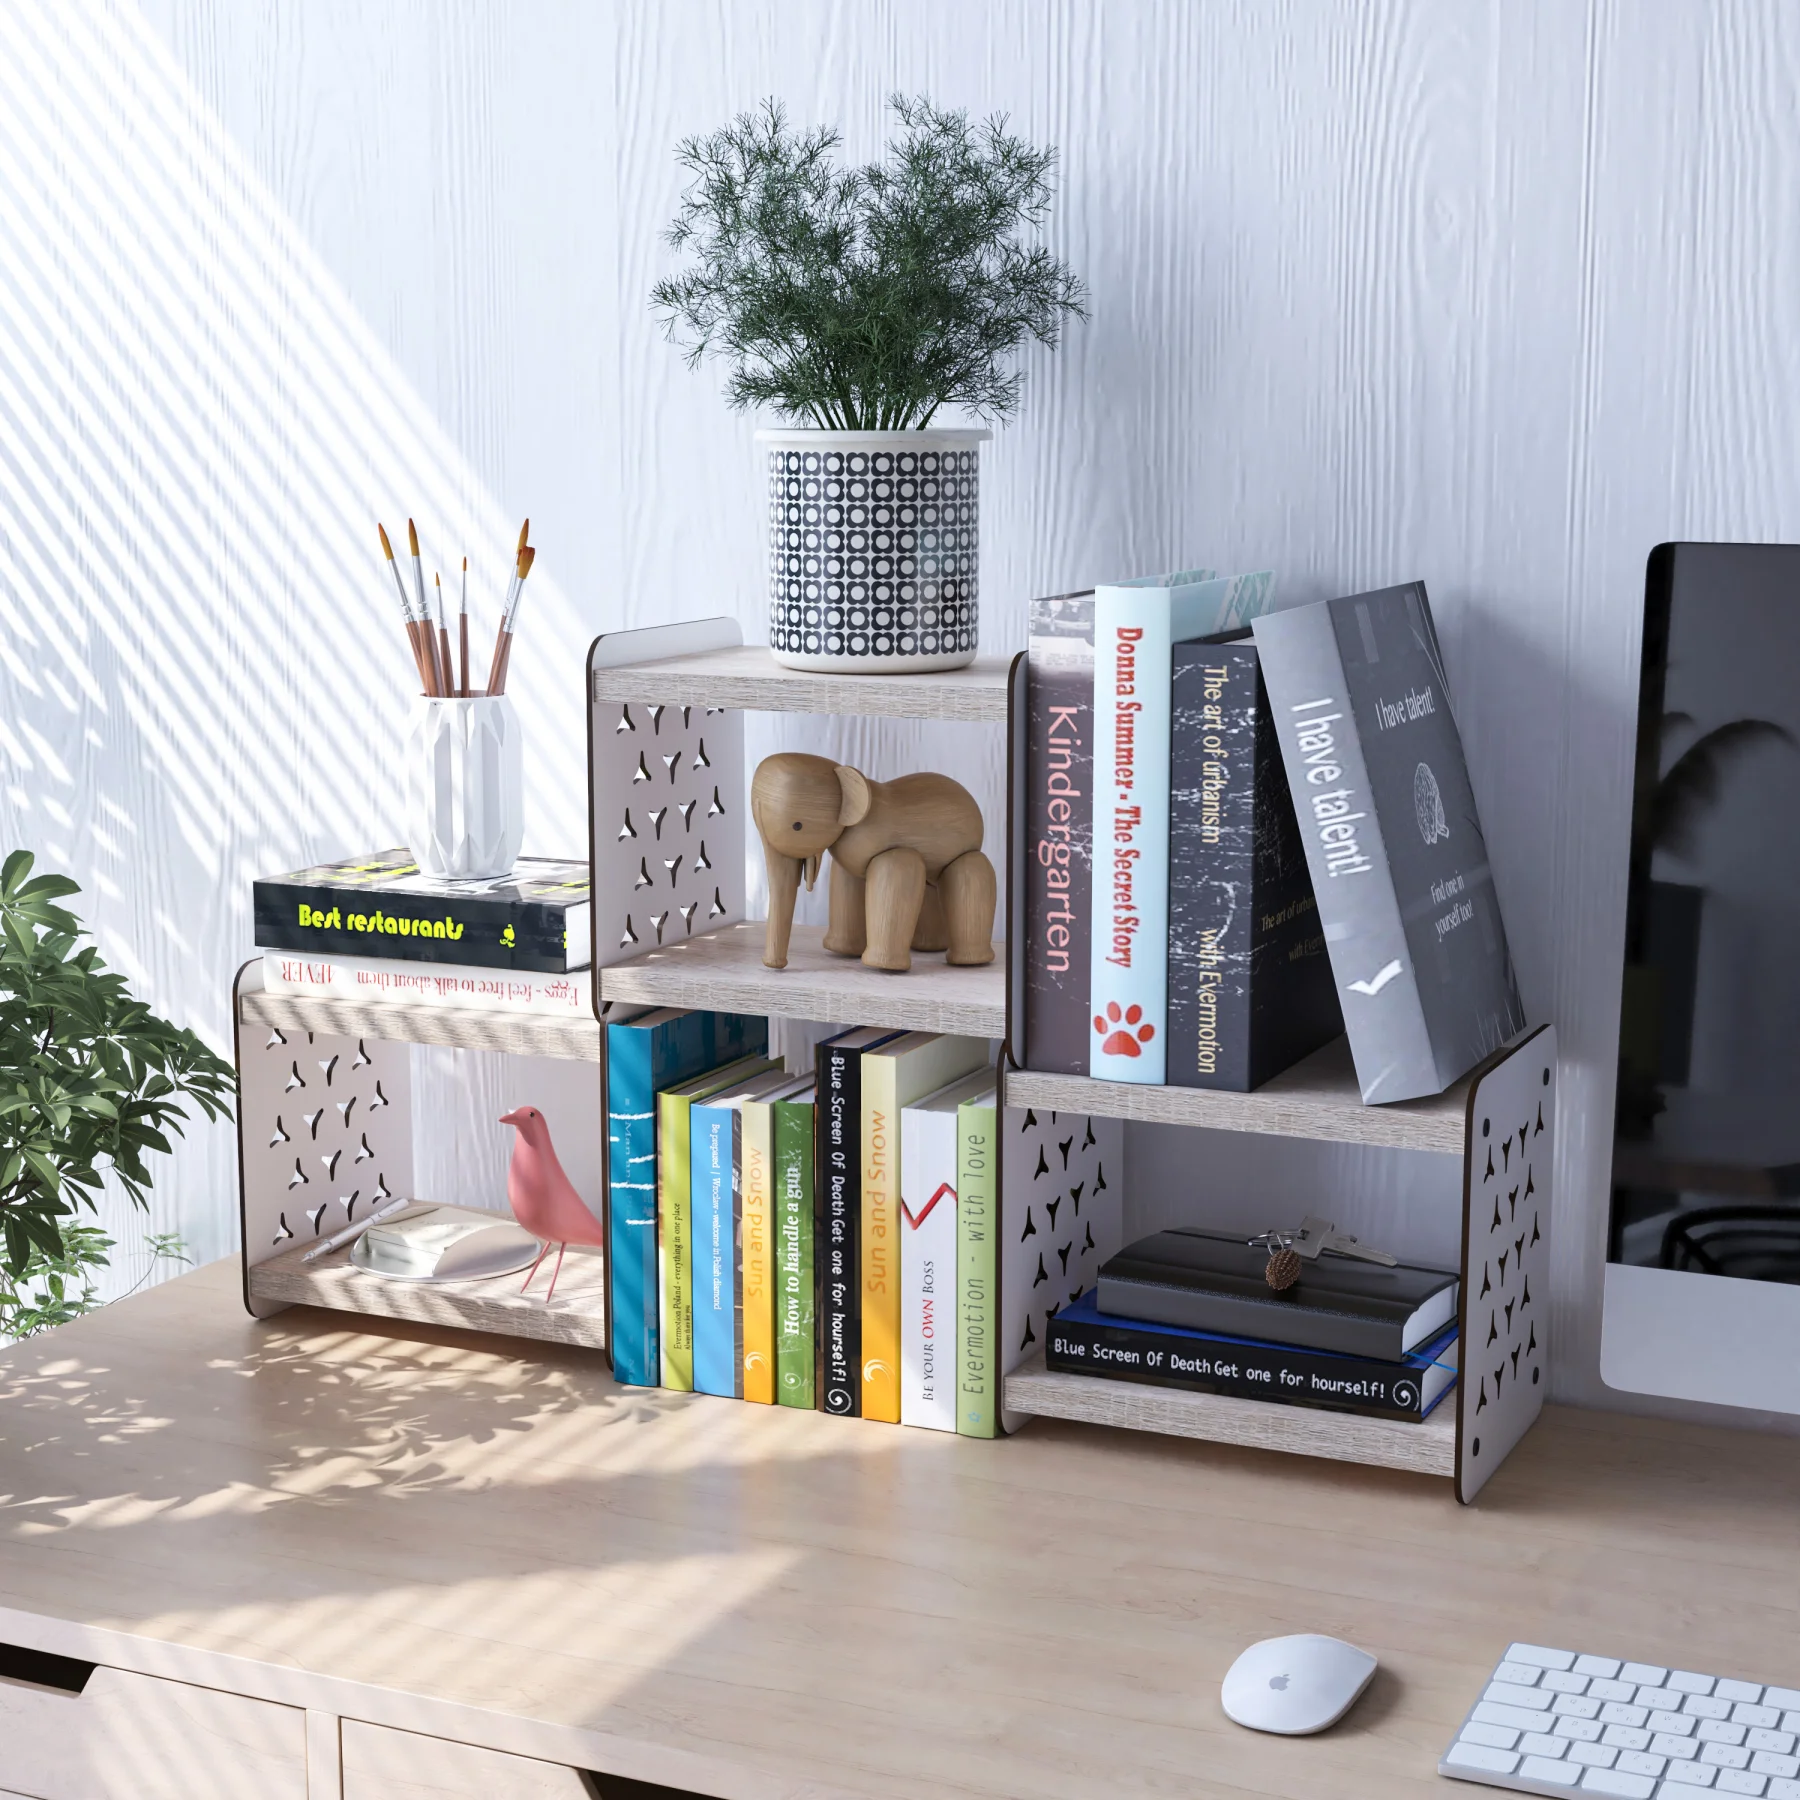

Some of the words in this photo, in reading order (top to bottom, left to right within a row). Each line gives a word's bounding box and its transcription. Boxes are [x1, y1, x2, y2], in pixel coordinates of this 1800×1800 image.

[1115, 627, 1143, 696] Donna
[1203, 665, 1230, 700] The
[1203, 705, 1227, 731] art
[1290, 697, 1335, 712] I
[1375, 703, 1383, 731] I
[1380, 697, 1407, 729] have
[1404, 685, 1436, 721] talent!
[1114, 701, 1143, 790] Summer
[1203, 735, 1229, 759] of
[1294, 713, 1343, 785] have
[1202, 761, 1229, 844] urbanism
[1037, 705, 1082, 973] Kindergarten
[1113, 805, 1142, 844] The
[1311, 789, 1374, 878] talent!
[1113, 848, 1141, 911] Secret
[1430, 879, 1446, 905] Find
[1445, 878, 1458, 898] one
[1455, 869, 1465, 891] in
[298, 903, 342, 930] Best
[346, 910, 465, 941] restaurants
[1435, 902, 1461, 943] yourself
[1106, 915, 1140, 968] Story
[1199, 929, 1225, 966] with
[281, 961, 336, 985] 4EVER
[356, 971, 391, 991] them
[393, 973, 431, 993] about
[433, 976, 459, 996] talk
[461, 978, 476, 994] to
[478, 981, 505, 999] free
[507, 983, 533, 1003] feel
[544, 980, 579, 1007] Eggs
[1198, 971, 1223, 1074] Evermotion
[830, 1055, 846, 1089] Blue
[711, 1123, 721, 1133] Be
[830, 1096, 846, 1145] Screen
[709, 1133, 721, 1169] prepared
[831, 1151, 846, 1170] Of
[867, 1109, 887, 1181] Snow
[962, 1134, 986, 1179] love
[747, 1147, 763, 1207] Snow
[784, 1167, 804, 1200] gun
[831, 1175, 846, 1216] Death
[673, 1202, 683, 1221] place
[786, 1203, 799, 1213] a
[866, 1190, 887, 1238] and
[963, 1195, 985, 1242] with
[712, 1214, 721, 1247] welcome
[746, 1213, 763, 1253] and
[783, 1215, 800, 1274] handle
[831, 1218, 846, 1243] Get
[673, 1244, 683, 1280] everything
[712, 1255, 722, 1277] Polish
[747, 1259, 763, 1299] Sun
[831, 1250, 843, 1276] one
[867, 1247, 887, 1294] Sun
[921, 1260, 934, 1294] BOSS
[673, 1286, 682, 1309] Poland
[713, 1277, 722, 1310] diamond
[785, 1276, 800, 1293] to
[831, 1282, 847, 1307] for
[673, 1310, 682, 1350] Evermotion
[783, 1295, 800, 1336] How
[921, 1299, 935, 1339] OWN
[831, 1312, 847, 1382] hourself!
[962, 1278, 985, 1394] Evermotion
[922, 1343, 934, 1380] YOUR
[1054, 1337, 1086, 1357] Blue
[1092, 1343, 1140, 1364] Screen
[1146, 1350, 1164, 1367] Of
[1170, 1354, 1211, 1374] Death
[1213, 1363, 1239, 1379] Get
[1246, 1368, 1272, 1383] one
[1279, 1369, 1304, 1387] for
[1311, 1373, 1386, 1399] hourself!
[922, 1385, 934, 1401] BE
